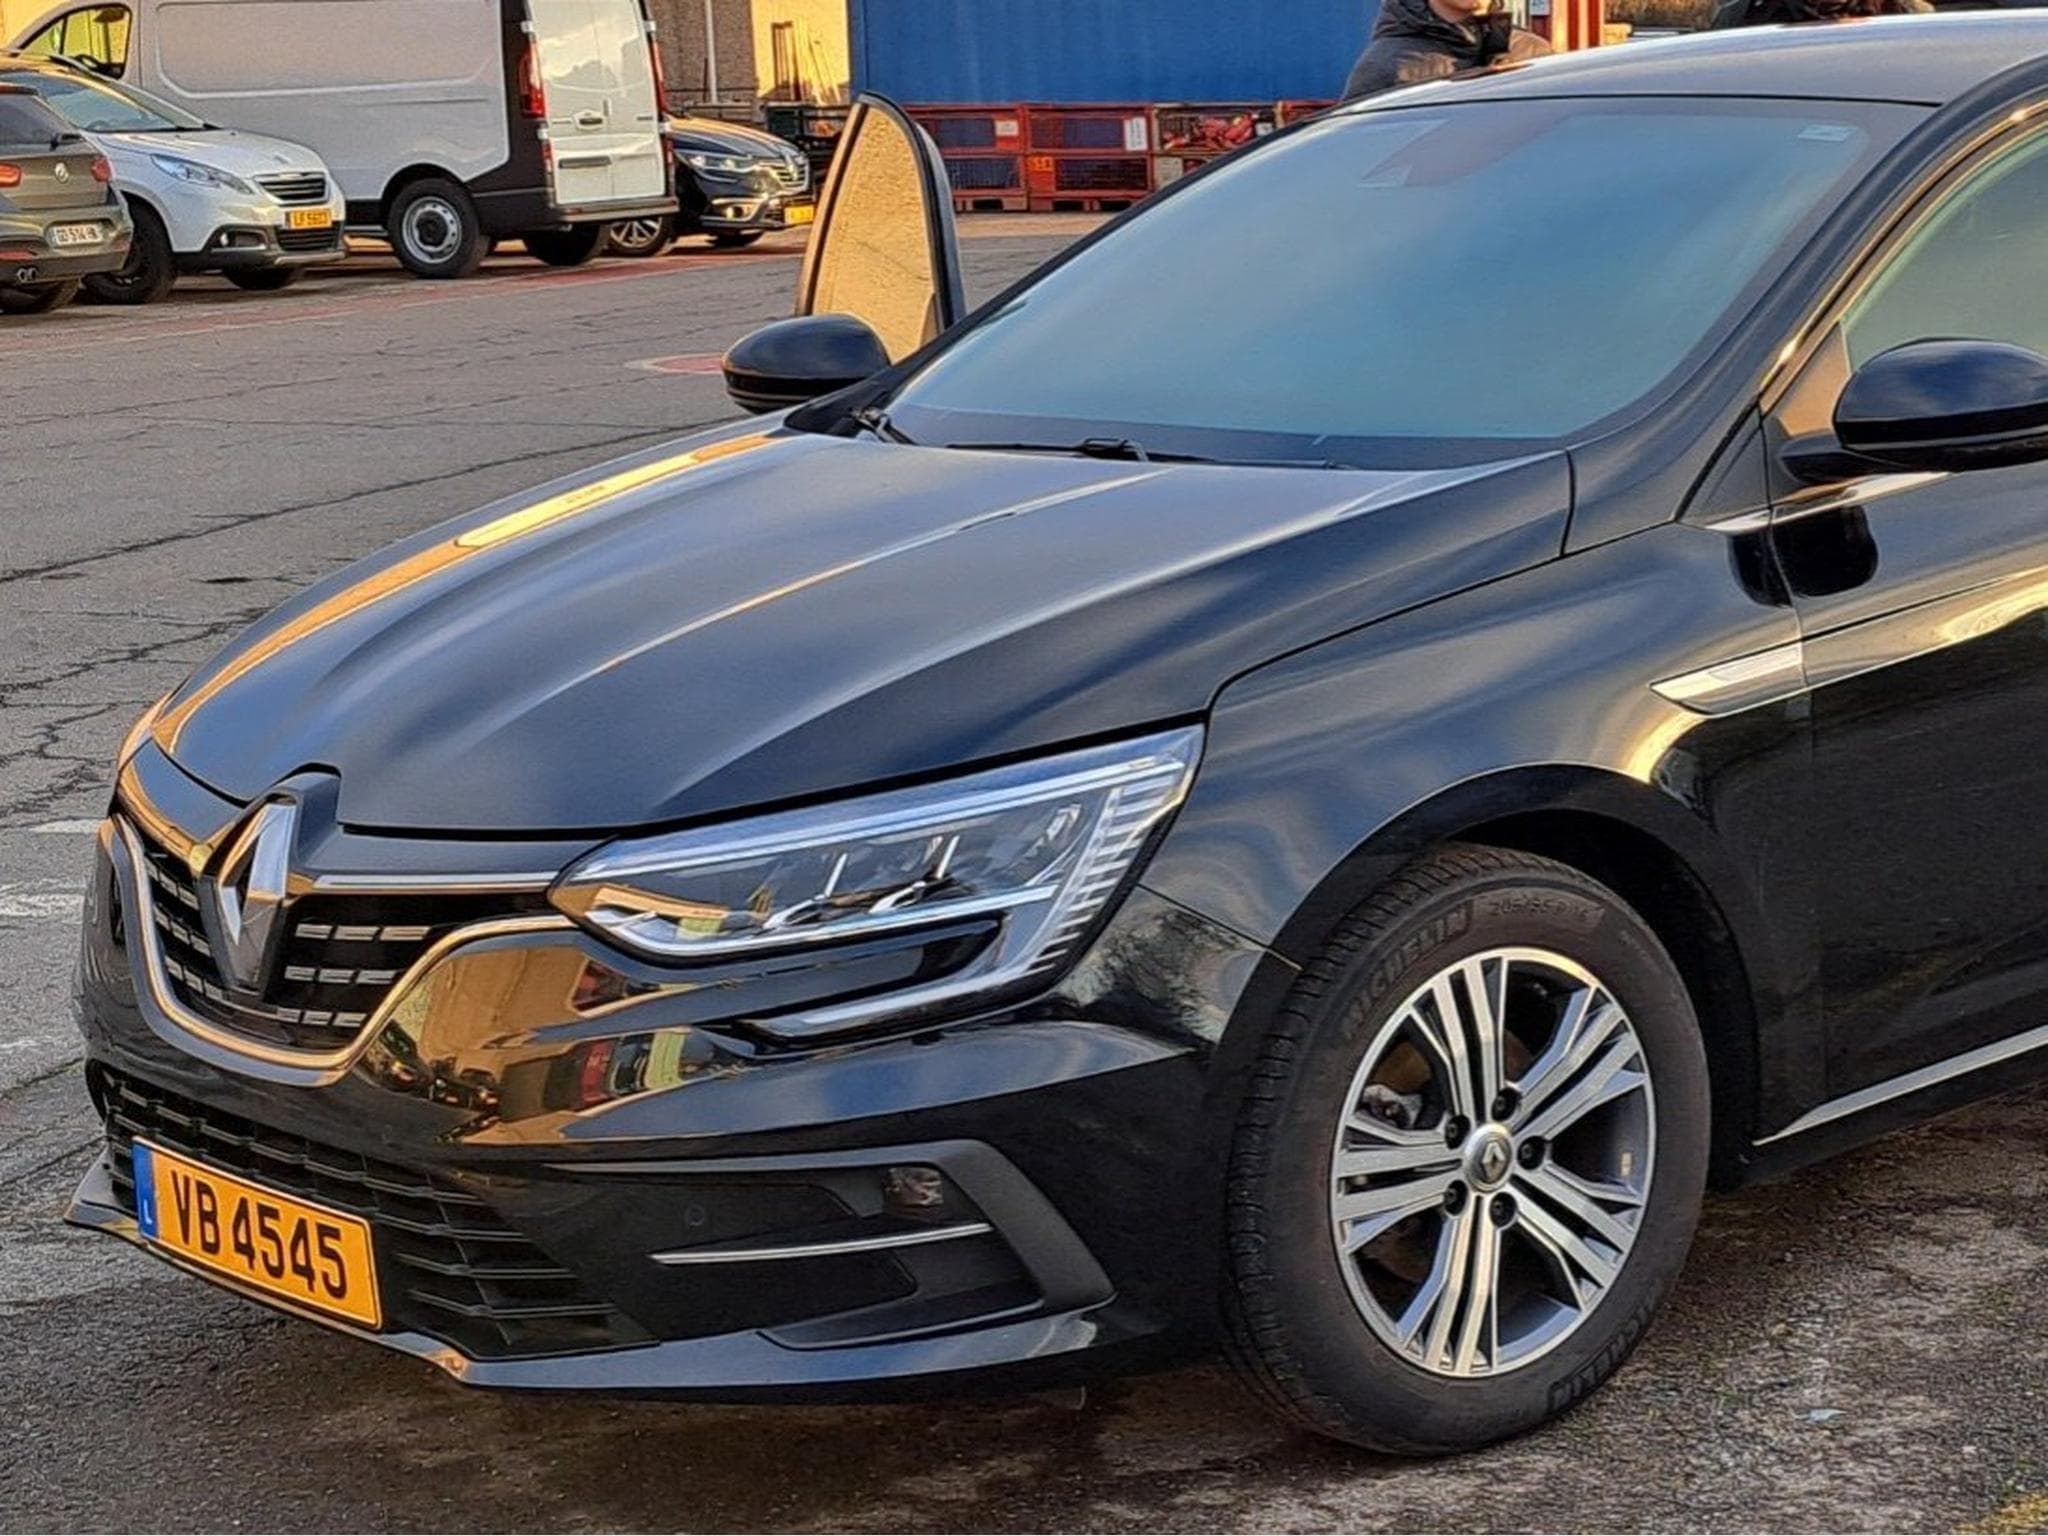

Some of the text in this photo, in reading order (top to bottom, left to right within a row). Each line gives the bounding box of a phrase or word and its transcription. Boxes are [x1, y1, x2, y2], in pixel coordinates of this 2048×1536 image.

[143, 1199, 153, 1225] L
[170, 1169, 348, 1300] VB 4545
